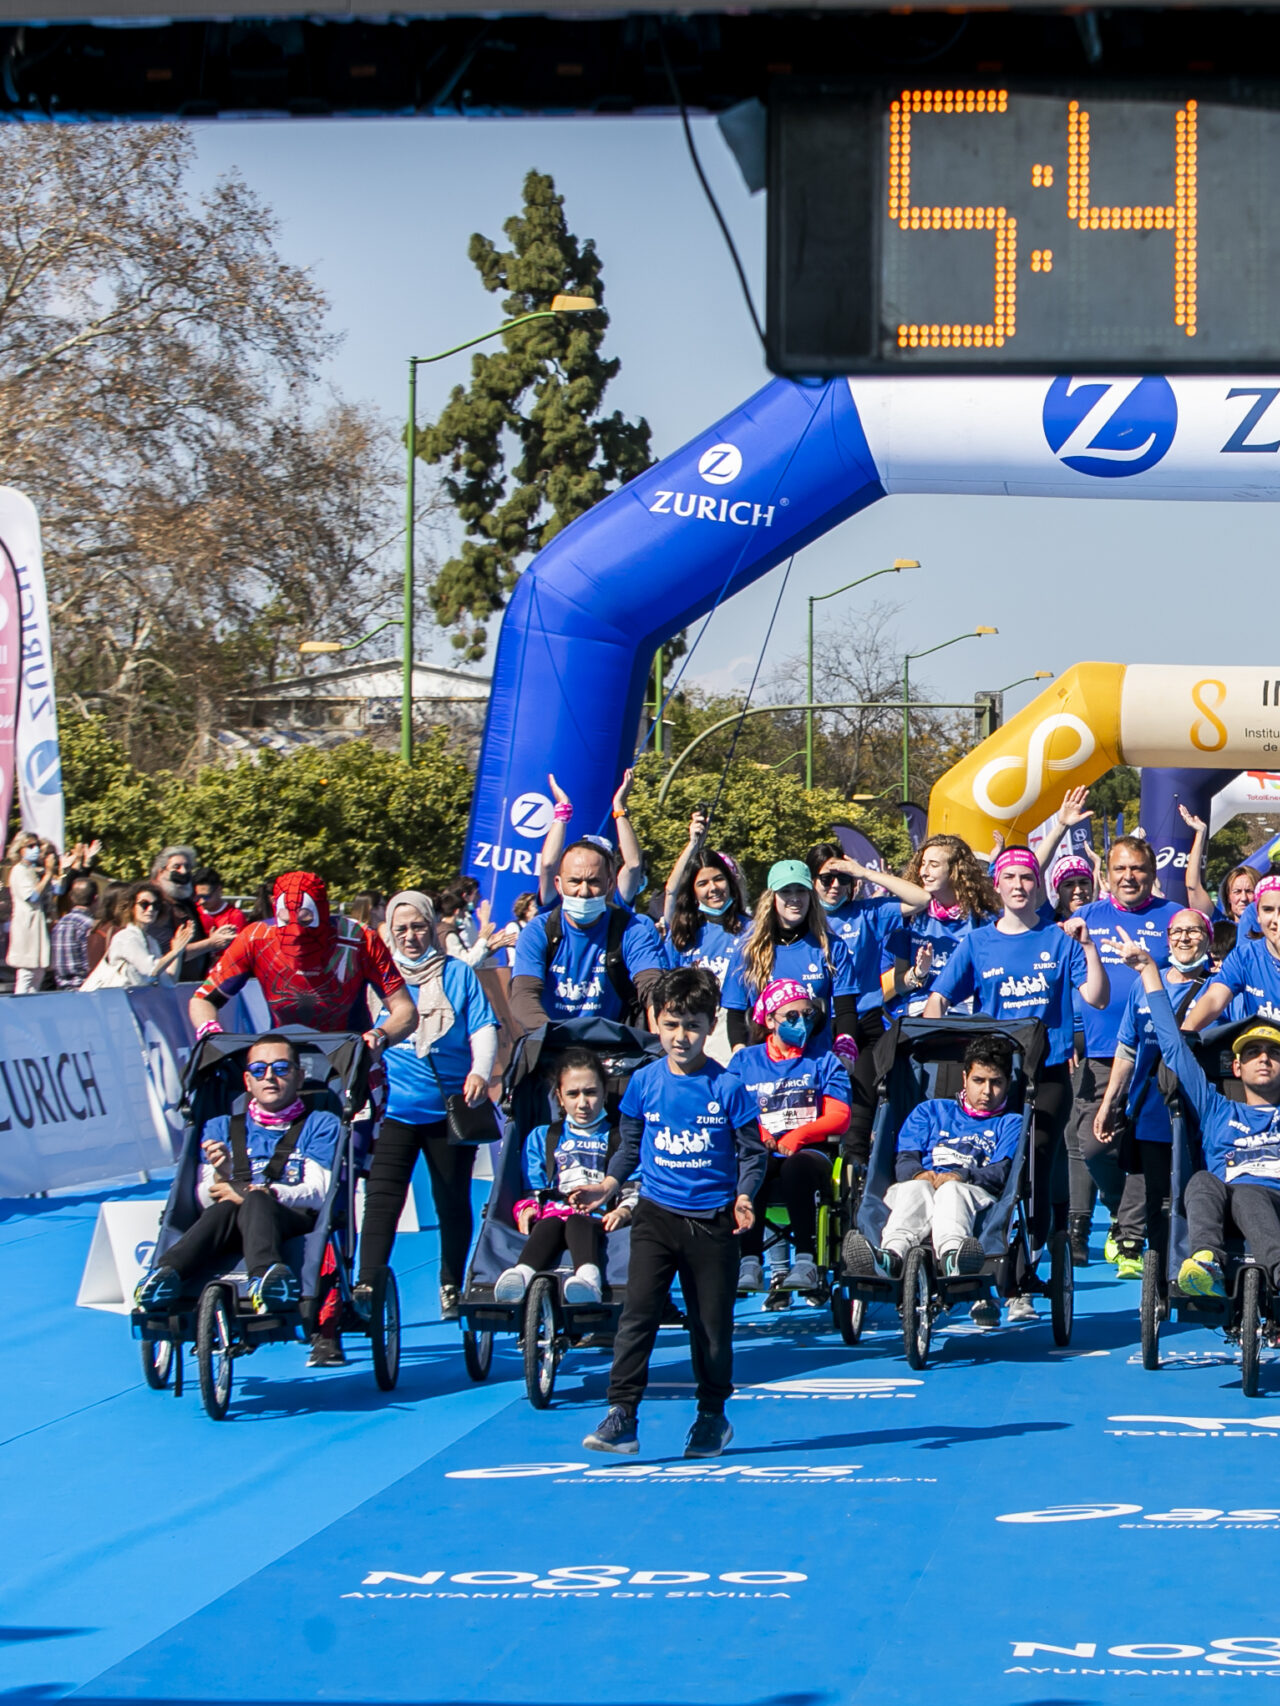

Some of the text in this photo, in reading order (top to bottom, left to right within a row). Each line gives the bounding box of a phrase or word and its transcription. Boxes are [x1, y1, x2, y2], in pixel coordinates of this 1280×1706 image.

[1263, 743, 1278, 752] de
[474, 842, 540, 877] ZURI
[584, 1465, 863, 1477] asics
